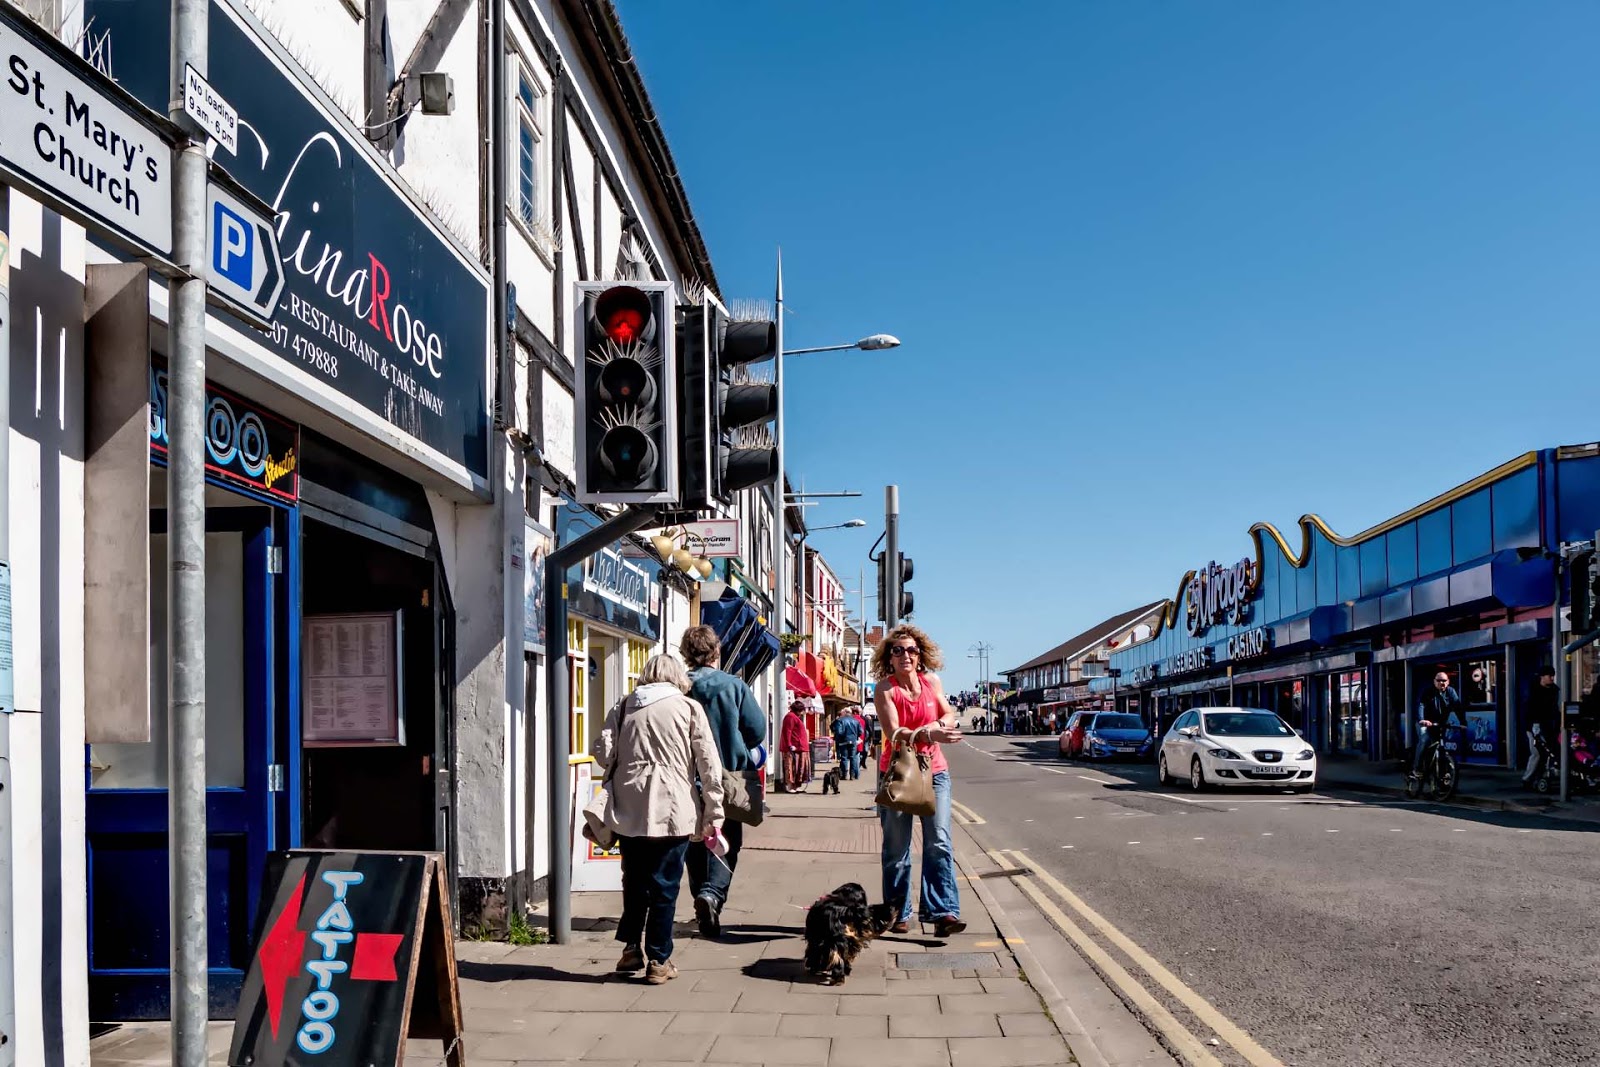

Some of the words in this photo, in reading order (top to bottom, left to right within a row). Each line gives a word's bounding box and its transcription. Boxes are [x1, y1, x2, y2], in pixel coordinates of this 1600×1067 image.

[8, 54, 54, 115] St.
[65, 90, 158, 182] Mary's
[189, 96, 195, 110] 9
[196, 105, 209, 124] am
[215, 120, 220, 134] 6
[221, 130, 234, 147] pm
[190, 75, 203, 96] No
[205, 88, 234, 128] loading
[34, 122, 139, 216] Church
[220, 211, 247, 272] P
[290, 292, 379, 371] RESTAURANT
[380, 357, 389, 379] &
[390, 364, 417, 399] TAKE
[418, 386, 444, 417] AWAY
[292, 334, 338, 379] 479888
[265, 448, 296, 489] Studio
[1227, 627, 1263, 660] CASINO
[1472, 742, 1493, 751] CASINO
[296, 870, 364, 1055] TATTOO
